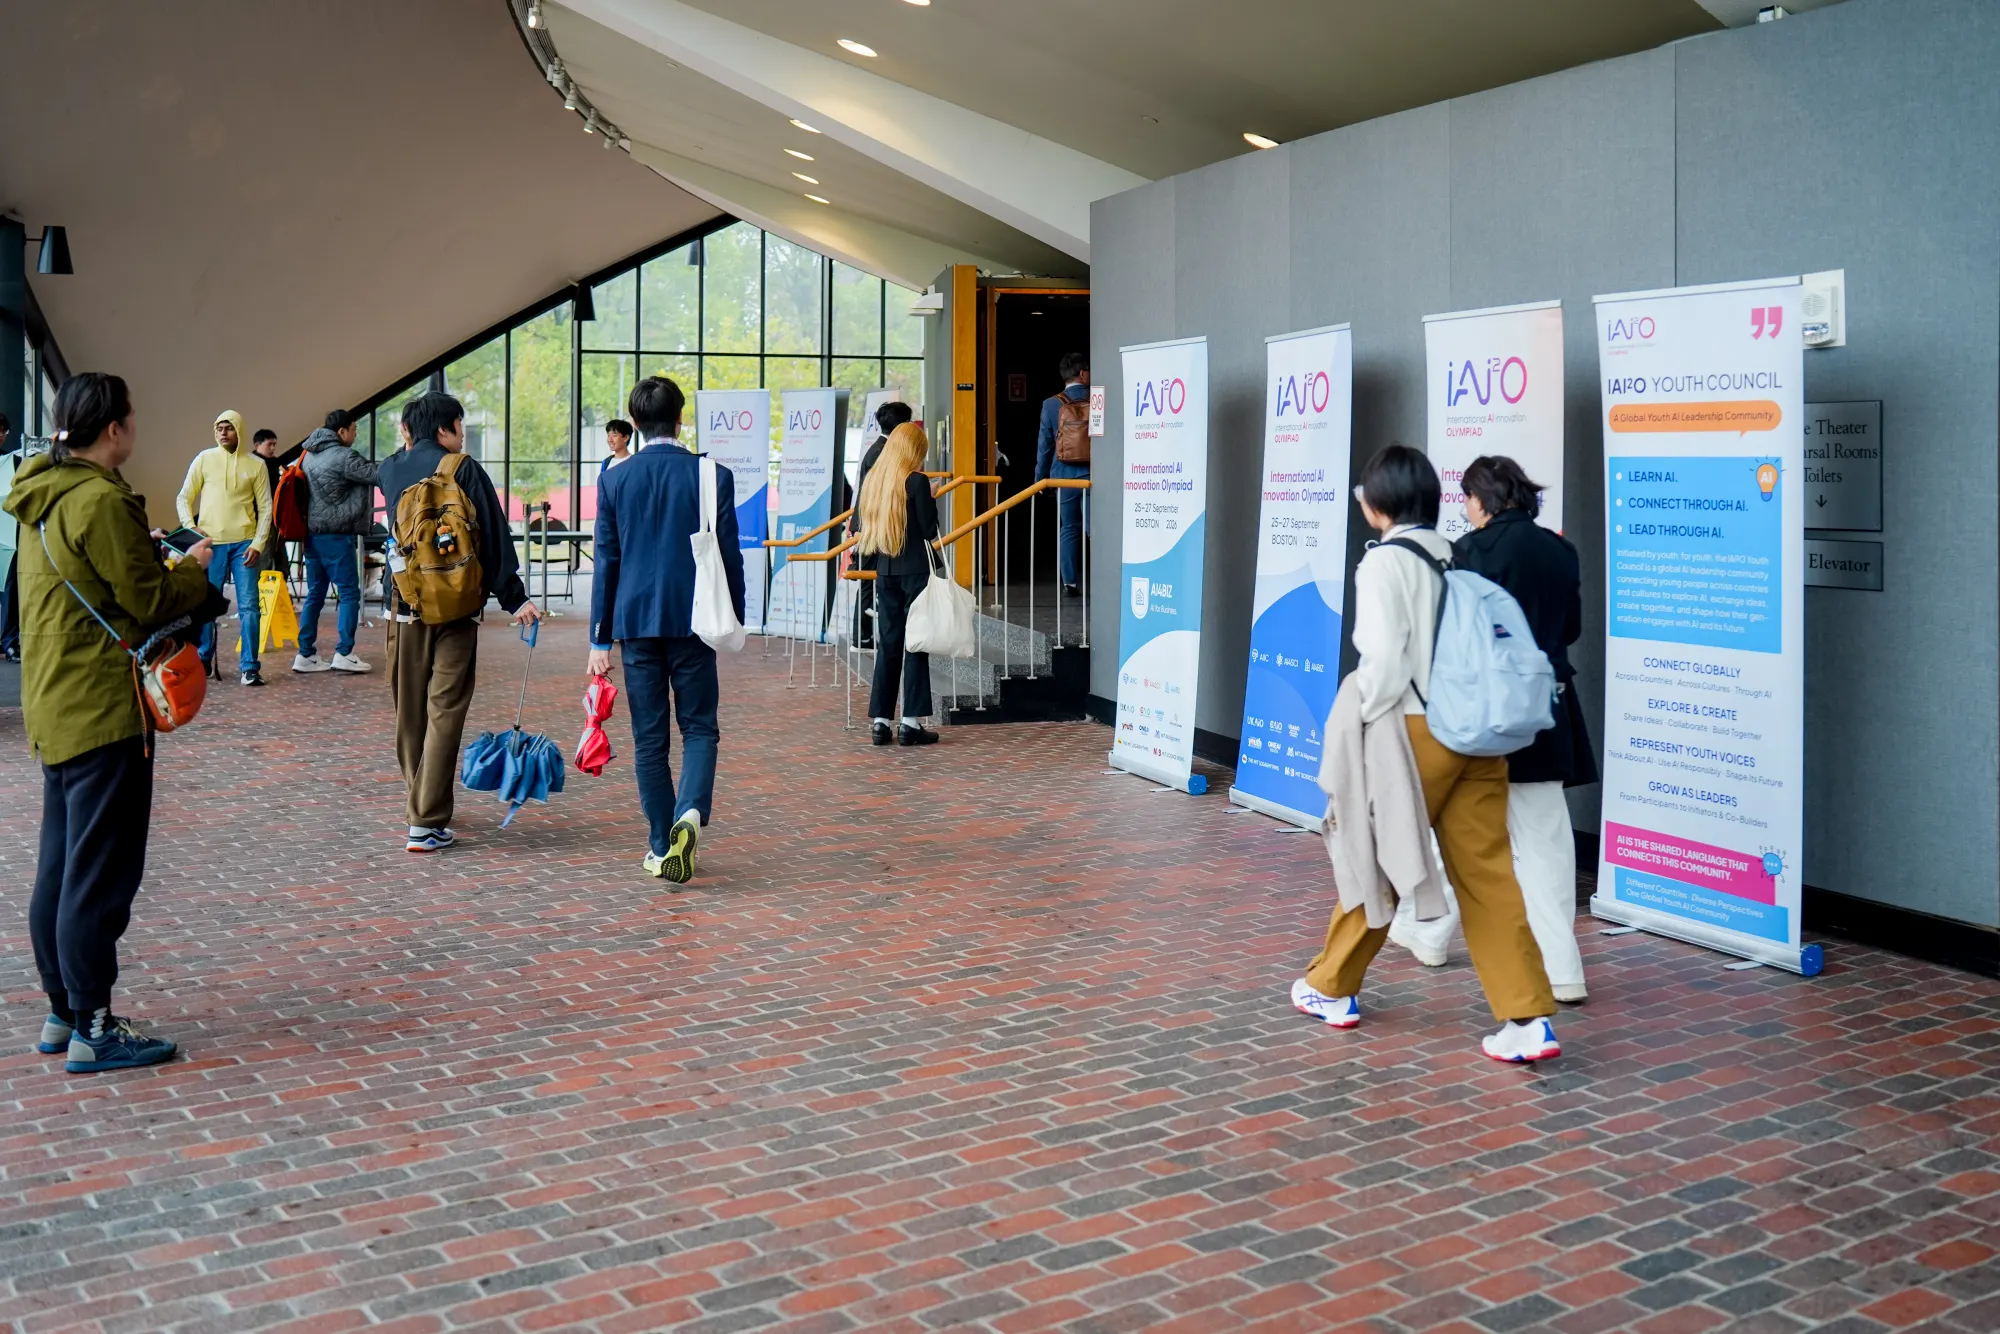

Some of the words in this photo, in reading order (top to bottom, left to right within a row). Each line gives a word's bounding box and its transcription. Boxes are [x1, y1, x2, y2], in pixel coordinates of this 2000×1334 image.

[1652, 375, 1703, 392] YOUTH
[1708, 372, 1782, 391] COUNCIL
[1447, 415, 1486, 424] International
[1488, 413, 1494, 422] AI
[1495, 413, 1526, 422] Innovation
[1620, 413, 1645, 422] Global
[1647, 413, 1670, 422] Youth
[1672, 412, 1680, 421] AI
[1681, 412, 1723, 422] Leadership
[1725, 411, 1774, 421] Community
[1446, 427, 1483, 436] OLYMPIAD
[1816, 419, 1868, 435] Theater
[1275, 434, 1299, 443] OLYMPIAD
[1834, 443, 1878, 459] Rooms
[733, 466, 760, 476] Olympiad
[1132, 462, 1174, 474] International
[1176, 462, 1182, 473] AI
[1270, 469, 1316, 482] International
[1317, 469, 1324, 482] AI
[1804, 467, 1842, 483] Toilets
[1629, 471, 1662, 482] LEARN
[1664, 472, 1678, 483] AI.
[1761, 472, 1773, 484] AI
[1162, 479, 1193, 493] Olympiad
[1302, 488, 1335, 504] Olympiad
[1153, 503, 1178, 515] September
[1629, 498, 1682, 510] CONNECT
[1682, 498, 1733, 511] THROUGH
[1735, 500, 1748, 512] AI.
[1136, 519, 1159, 528] BOSTON
[1291, 518, 1320, 530] September
[1629, 524, 1655, 535] LEAD
[1658, 525, 1709, 538] THROUGH
[1711, 527, 1724, 538] AI.
[1272, 534, 1297, 545] BOSTON
[1617, 549, 1645, 558] Initiated
[1647, 551, 1656, 560] by
[1809, 553, 1870, 572] Elevator
[1617, 562, 1644, 571] Council
[1658, 563, 1680, 574] global
[1690, 565, 1726, 577] leadership
[1727, 569, 1768, 581] community
[1617, 576, 1658, 587] connecting
[1659, 578, 1682, 588] young
[1683, 580, 1709, 589] people
[1710, 582, 1733, 590] across
[1734, 583, 1768, 593] countries
[1617, 588, 1630, 596] and
[1632, 589, 1661, 599] cultures
[1672, 592, 1698, 602] explore
[1710, 596, 1744, 607] exchange
[1617, 602, 1639, 610] create
[1677, 606, 1690, 614] and
[1692, 607, 1714, 617] shape
[1715, 608, 1730, 618] how
[1732, 610, 1748, 620] their
[1643, 617, 1674, 628] engages
[1675, 618, 1690, 628] with
[1644, 657, 1690, 671] CONNECT
[1693, 662, 1741, 678] GLOBALLY
[1615, 672, 1637, 682] Across
[1639, 674, 1672, 686] Countries
[1677, 679, 1700, 689] Across
[1702, 682, 1730, 693] Cultures
[1735, 686, 1762, 698] Through
[1648, 699, 1690, 714] EXPLORE
[1693, 705, 1699, 715] &
[1702, 706, 1737, 720] CREATE
[1624, 713, 1643, 723] Share
[1644, 716, 1663, 725] Ideas
[1668, 719, 1708, 732] Collaborate
[1713, 726, 1729, 736] Build
[1731, 729, 1762, 741] Together
[1630, 737, 1683, 754] REPRESENT
[1685, 745, 1717, 760] YOUTH
[1719, 752, 1755, 767] VOICES
[1608, 750, 1623, 759] Think
[1624, 752, 1645, 763] About
[1658, 759, 1670, 767] Use
[1680, 762, 1721, 777] Responsibly
[1725, 770, 1747, 782] Shape
[1759, 777, 1783, 788] Future
[1649, 781, 1680, 796] GROW
[1682, 788, 1694, 798] AS
[1696, 791, 1738, 807] LEADERS
[1620, 792, 1636, 801] From
[1638, 795, 1678, 810] Participants
[1680, 802, 1687, 811] to
[1688, 804, 1717, 818] Initiators
[1726, 812, 1767, 828] Co-Builders
[1617, 835, 1625, 844] AI
[1626, 837, 1633, 845] IS
[1634, 838, 1649, 849] THE
[1650, 842, 1682, 857] SHARED
[1683, 850, 1727, 867] LANGUAGE
[1728, 859, 1749, 872] THAT
[1617, 846, 1661, 864] CONNECTS
[1662, 857, 1679, 868] THIS
[1680, 861, 1732, 881] COMMUNITY.
[1626, 878, 1655, 890] Different
[1656, 884, 1687, 899] Countries
[1691, 894, 1717, 907] Diverse
[1718, 900, 1763, 918] Perspectives
[1626, 889, 1640, 898] One
[1641, 893, 1662, 904] Global
[1664, 898, 1681, 908] Youth
[1683, 903, 1690, 911] AI
[1691, 904, 1730, 922] Community
